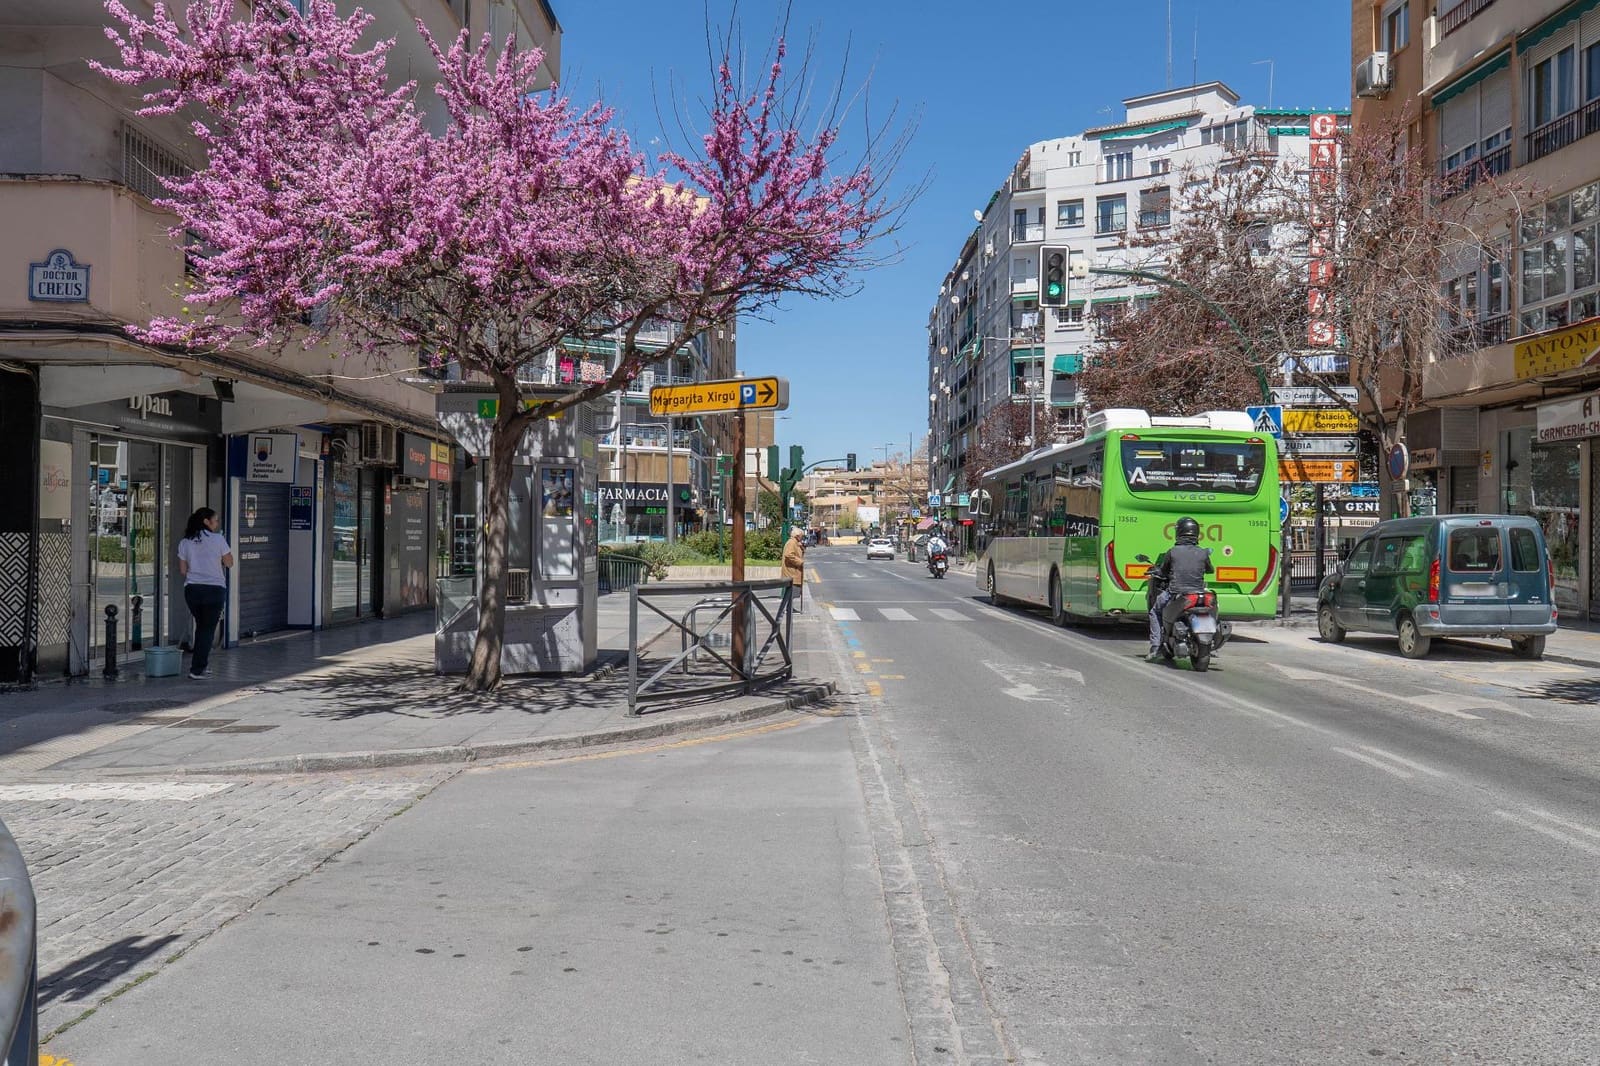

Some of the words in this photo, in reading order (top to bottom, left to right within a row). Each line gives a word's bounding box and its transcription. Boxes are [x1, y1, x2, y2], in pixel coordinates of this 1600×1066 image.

[43, 270, 78, 280] DOCTOR
[1521, 328, 1598, 360] ANTONI
[652, 393, 703, 408] Margarita
[707, 390, 736, 404] Xirgú
[1315, 422, 1358, 430] Congresos
[1284, 442, 1312, 450] ZUBIA
[598, 487, 669, 501] FARMACIA
